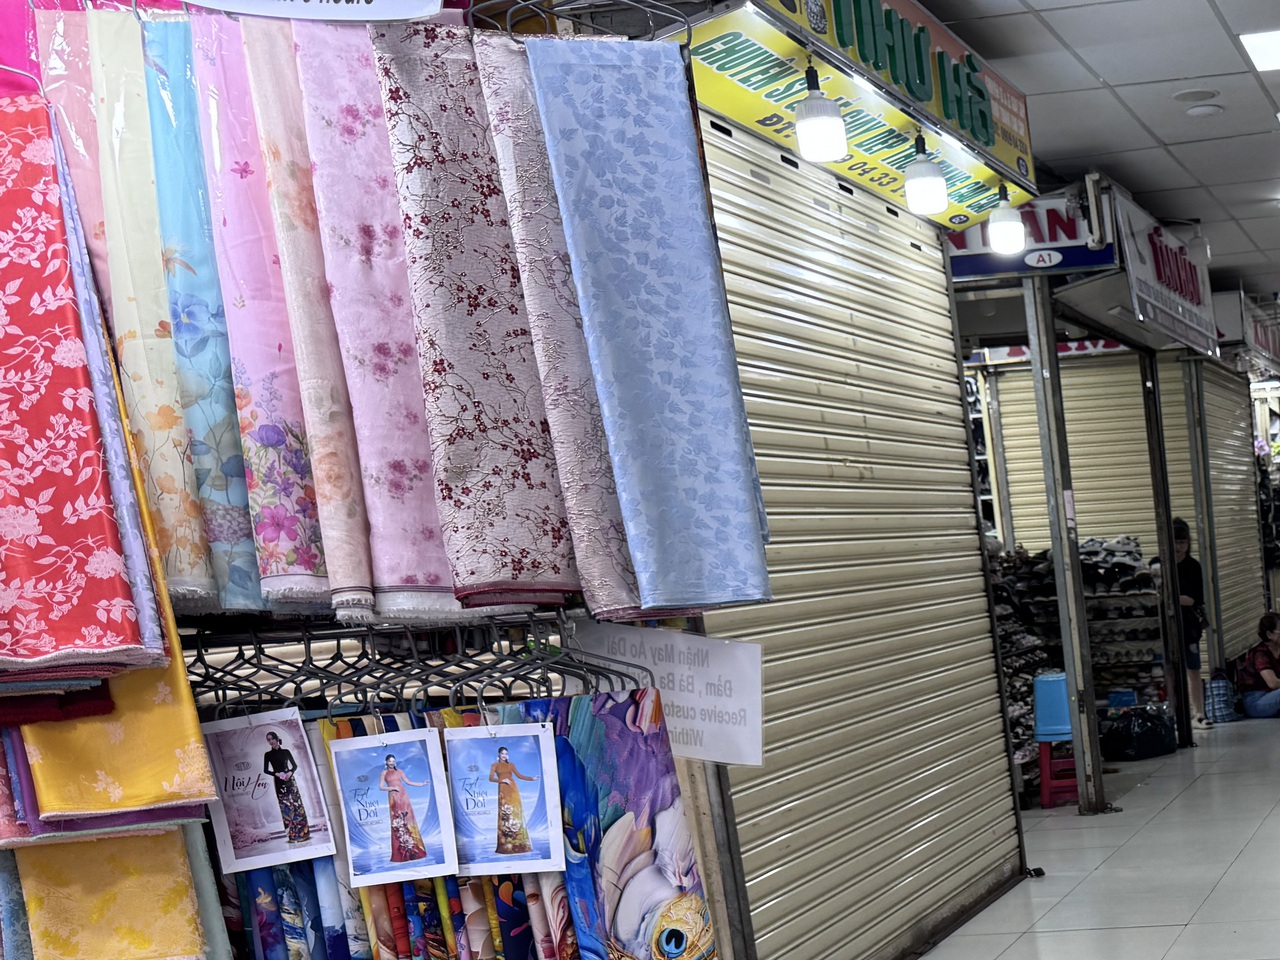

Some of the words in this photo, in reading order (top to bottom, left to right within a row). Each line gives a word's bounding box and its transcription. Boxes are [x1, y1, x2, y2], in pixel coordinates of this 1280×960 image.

[690, 31, 800, 92] CHUYÊN
[848, 162, 878, 177] 04
[869, 173, 898, 187] 33
[1036, 253, 1053, 265] A1
